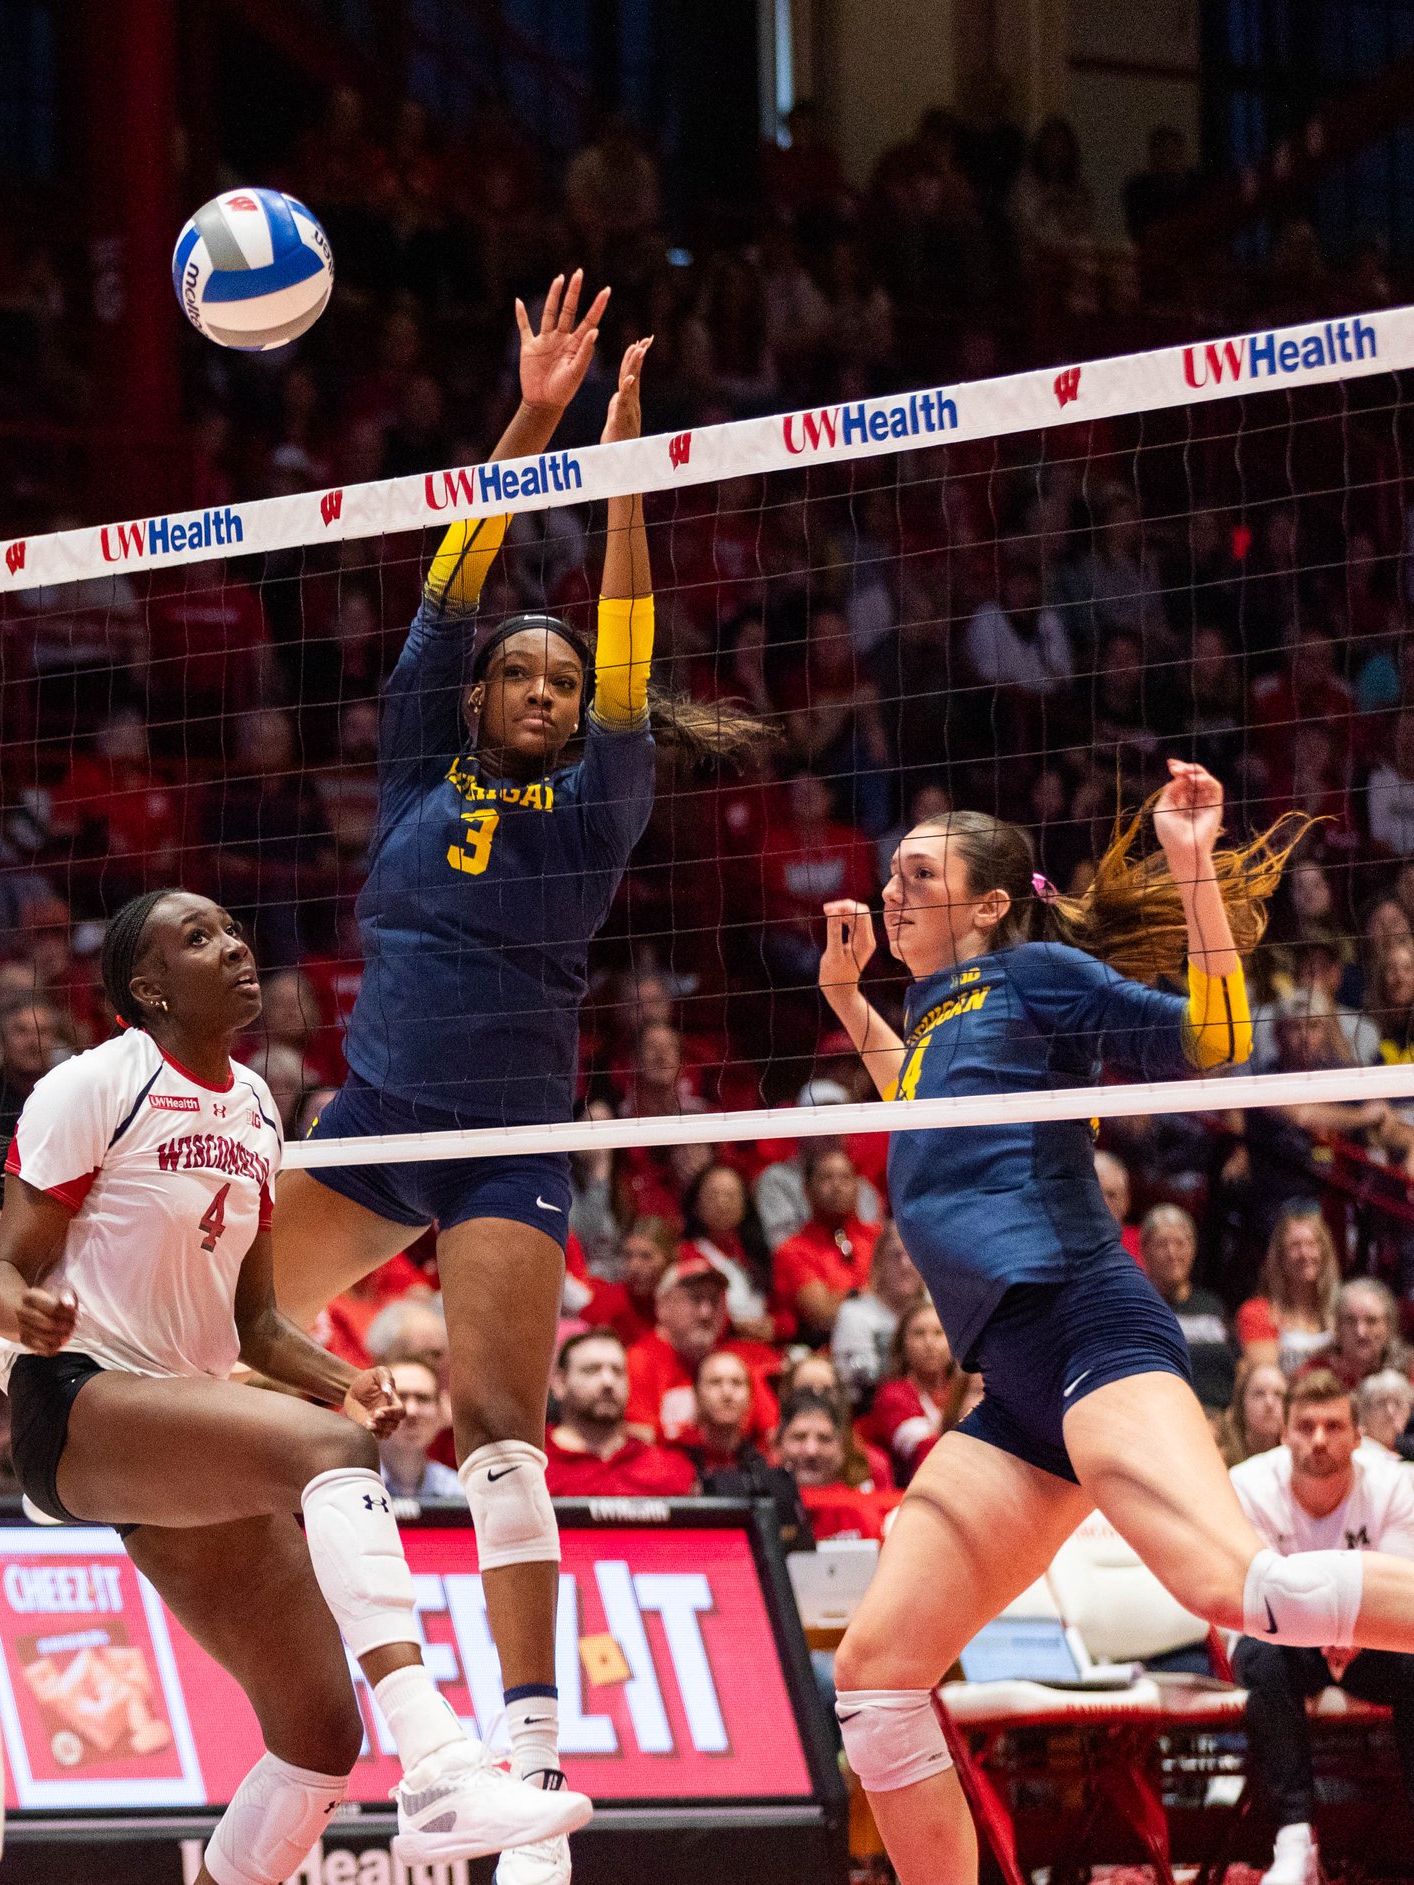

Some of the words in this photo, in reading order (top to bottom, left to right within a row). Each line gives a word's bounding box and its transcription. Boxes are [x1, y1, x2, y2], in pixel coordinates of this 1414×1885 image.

[446, 808, 500, 876] 3
[157, 1133, 270, 1186] WISCONSIN
[198, 1182, 231, 1253] 4
